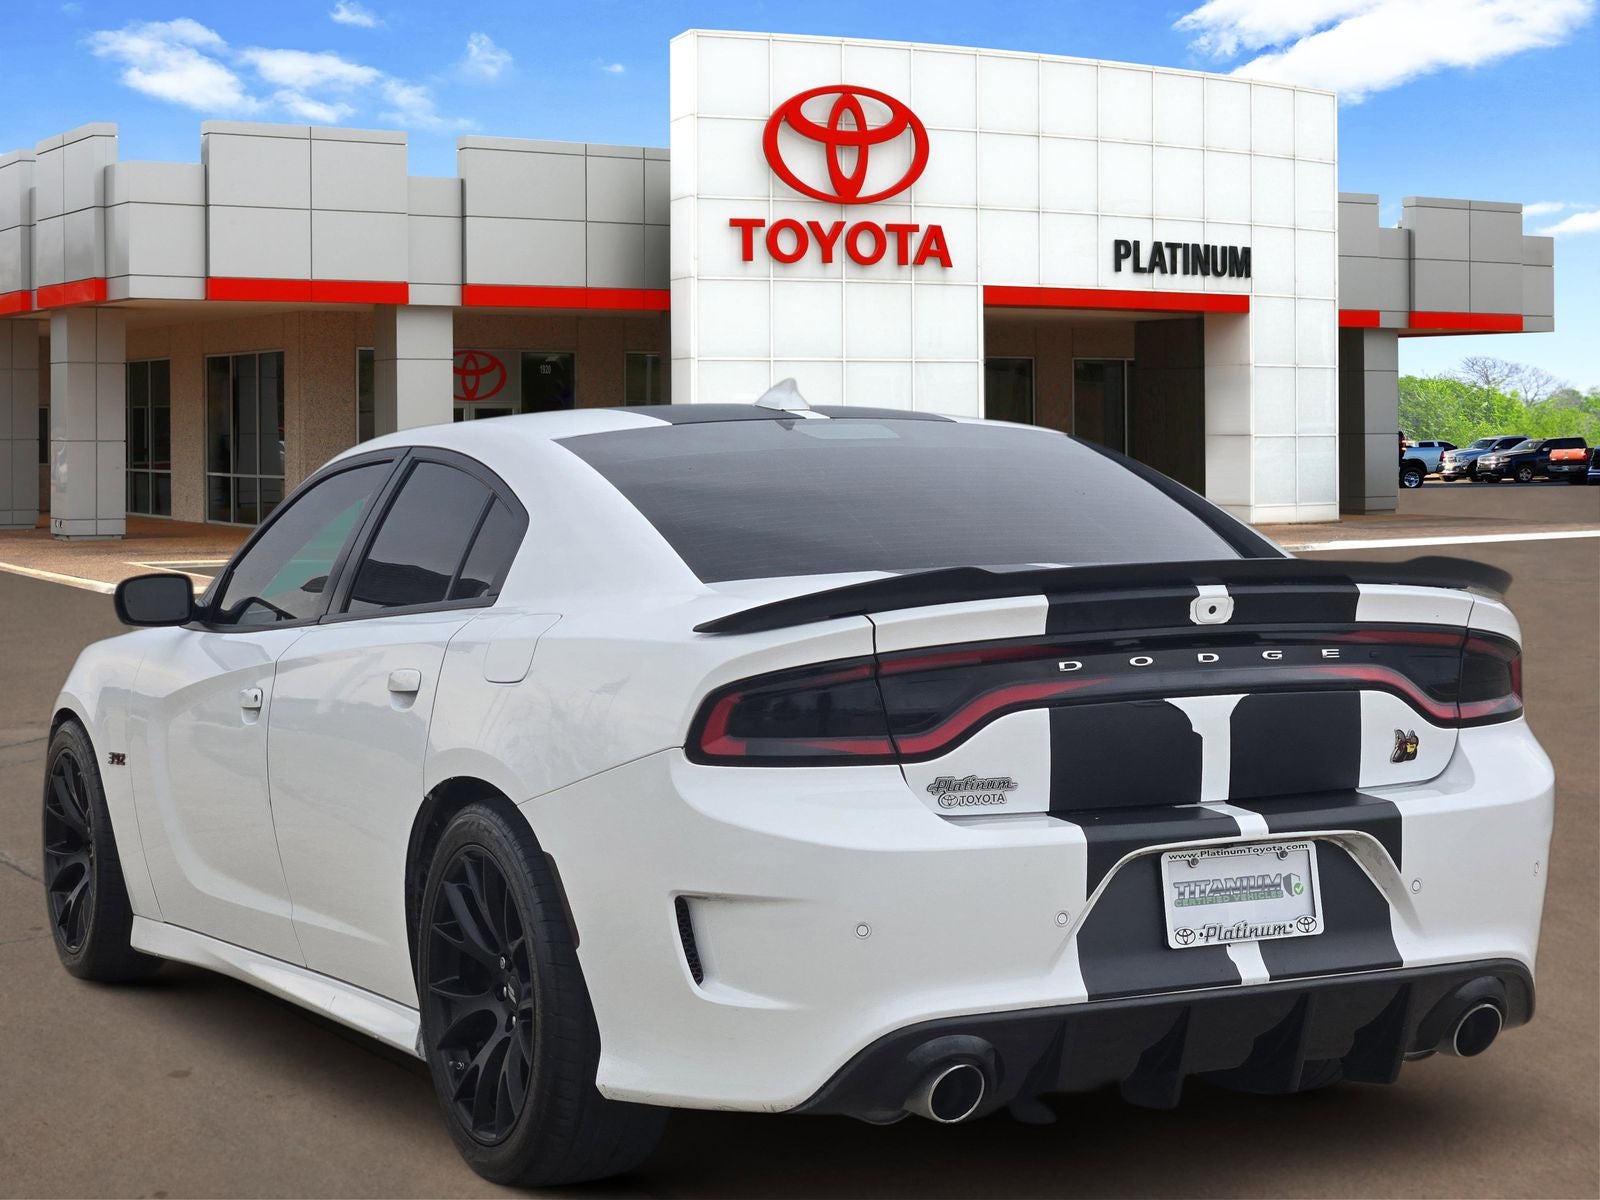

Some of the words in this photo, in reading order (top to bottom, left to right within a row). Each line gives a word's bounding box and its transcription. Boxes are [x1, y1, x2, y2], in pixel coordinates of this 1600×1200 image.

[729, 218, 953, 268] TOYOTA
[1113, 239, 1252, 278] PLATINUM
[1058, 648, 1340, 671] DODGE
[928, 775, 1017, 794] Platinum
[960, 793, 1005, 805] TOYOTA
[1168, 843, 1308, 860] www.PlatinumToyota.com
[1173, 873, 1282, 899] TITANIUM
[1174, 893, 1231, 907] CERTIFIED
[1233, 889, 1284, 902] VEHICLES
[1204, 921, 1293, 942] Platinum
